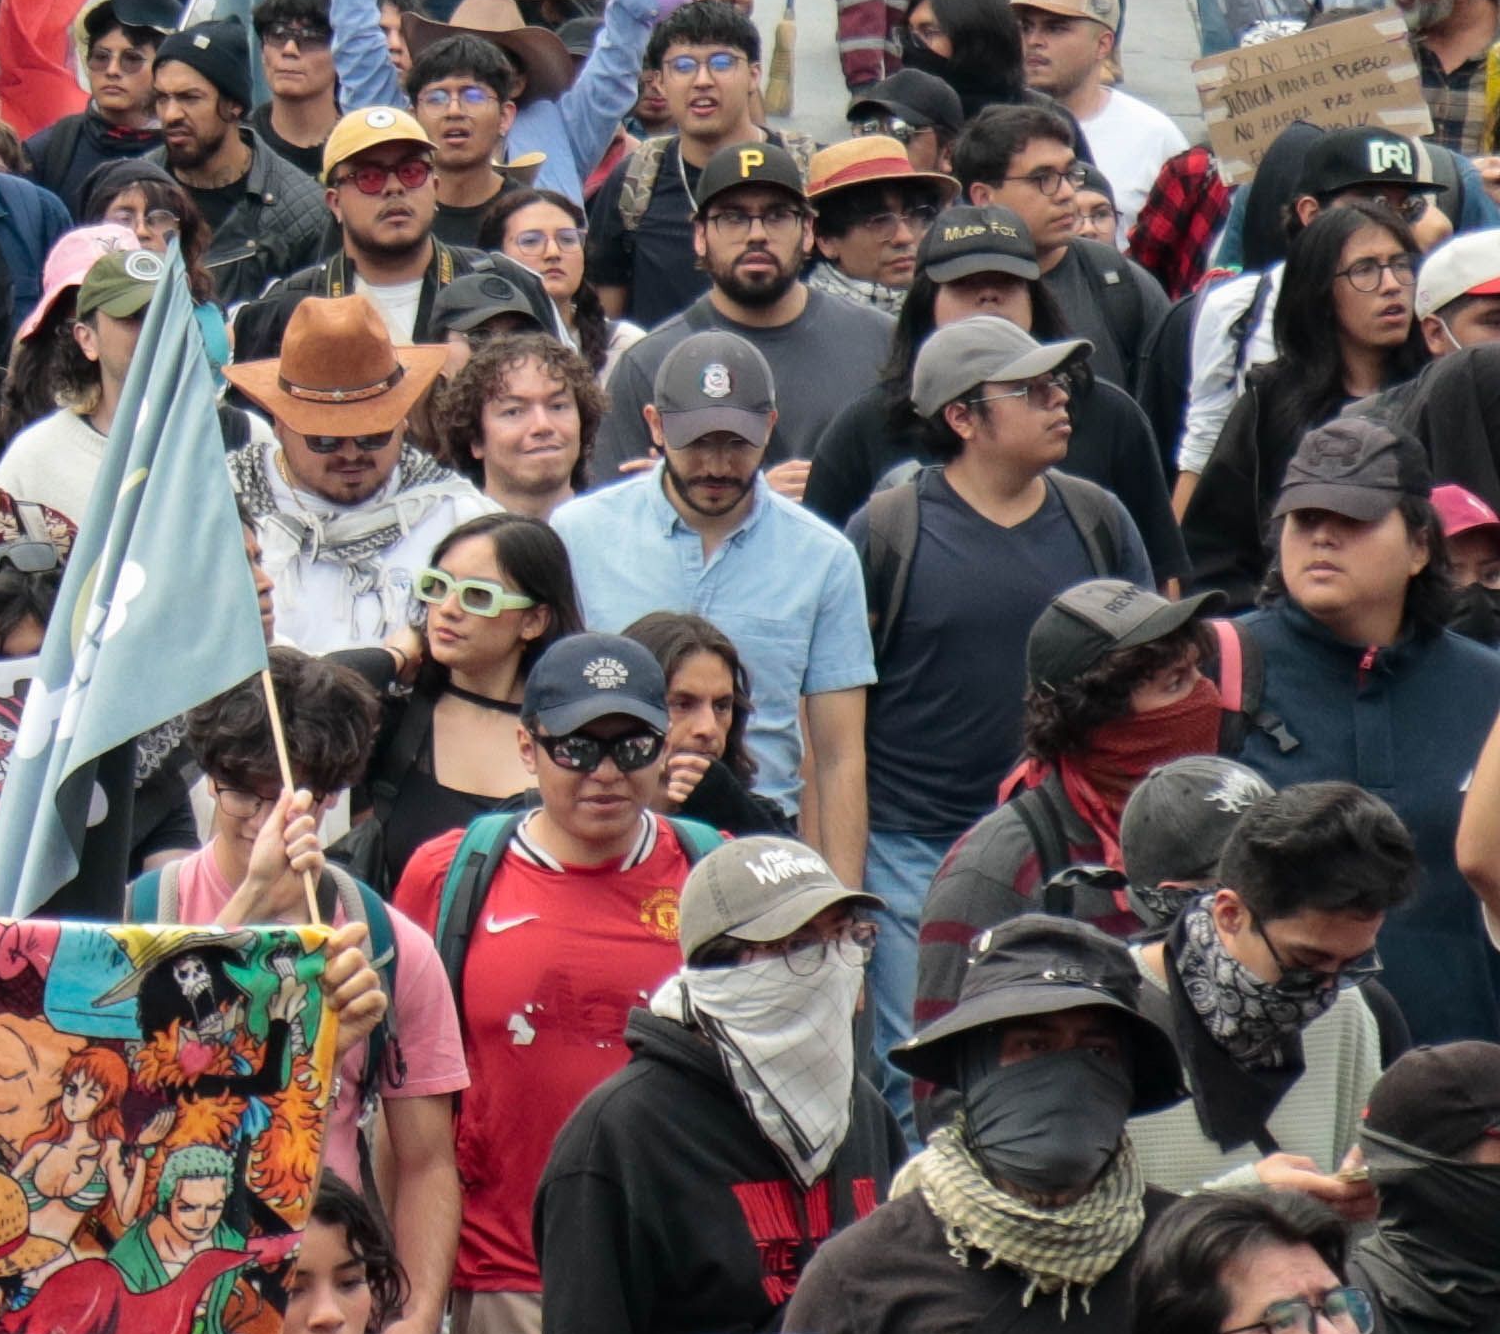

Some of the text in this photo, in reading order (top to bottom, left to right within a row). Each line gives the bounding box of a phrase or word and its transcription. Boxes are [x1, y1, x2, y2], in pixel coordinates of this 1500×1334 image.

[1258, 38, 1334, 78] NO HAY
[1331, 54, 1392, 81] PUEBLO
[1234, 121, 1255, 144] NO
[739, 149, 765, 179] P
[989, 221, 1019, 239] Fox
